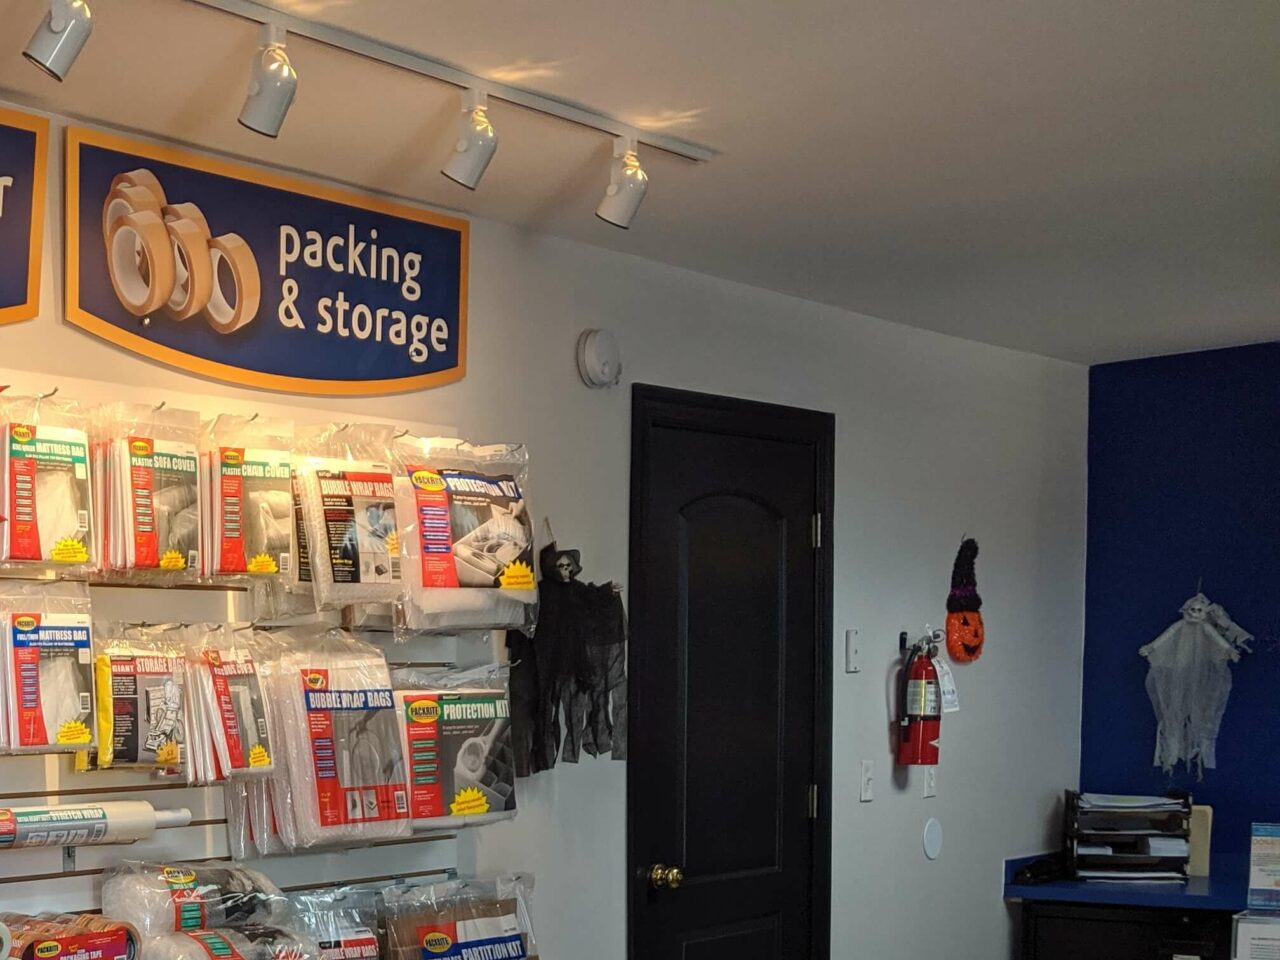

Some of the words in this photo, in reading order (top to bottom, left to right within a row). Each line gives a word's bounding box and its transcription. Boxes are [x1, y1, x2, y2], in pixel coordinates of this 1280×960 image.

[279, 224, 422, 301] packing
[278, 279, 305, 329] &
[317, 292, 448, 363] storage
[154, 456, 170, 469] SOFA
[172, 458, 196, 471] COVER
[265, 466, 289, 477] COVER
[322, 480, 350, 495] BUBBLE
[352, 481, 374, 496] WRAP
[376, 482, 394, 497] BAGS
[38, 629, 71, 641] MATTRESS
[73, 630, 87, 641] BAG
[136, 657, 168, 673] STORAGE
[411, 704, 438, 715] PACKRITE
[444, 703, 494, 719] PROTECTION
[51, 809, 83, 821] STRETCH
[84, 808, 104, 819] WRAP
[425, 937, 449, 947] PACKRITE
[506, 941, 522, 957] KIT
[89, 950, 103, 960] TAPE
